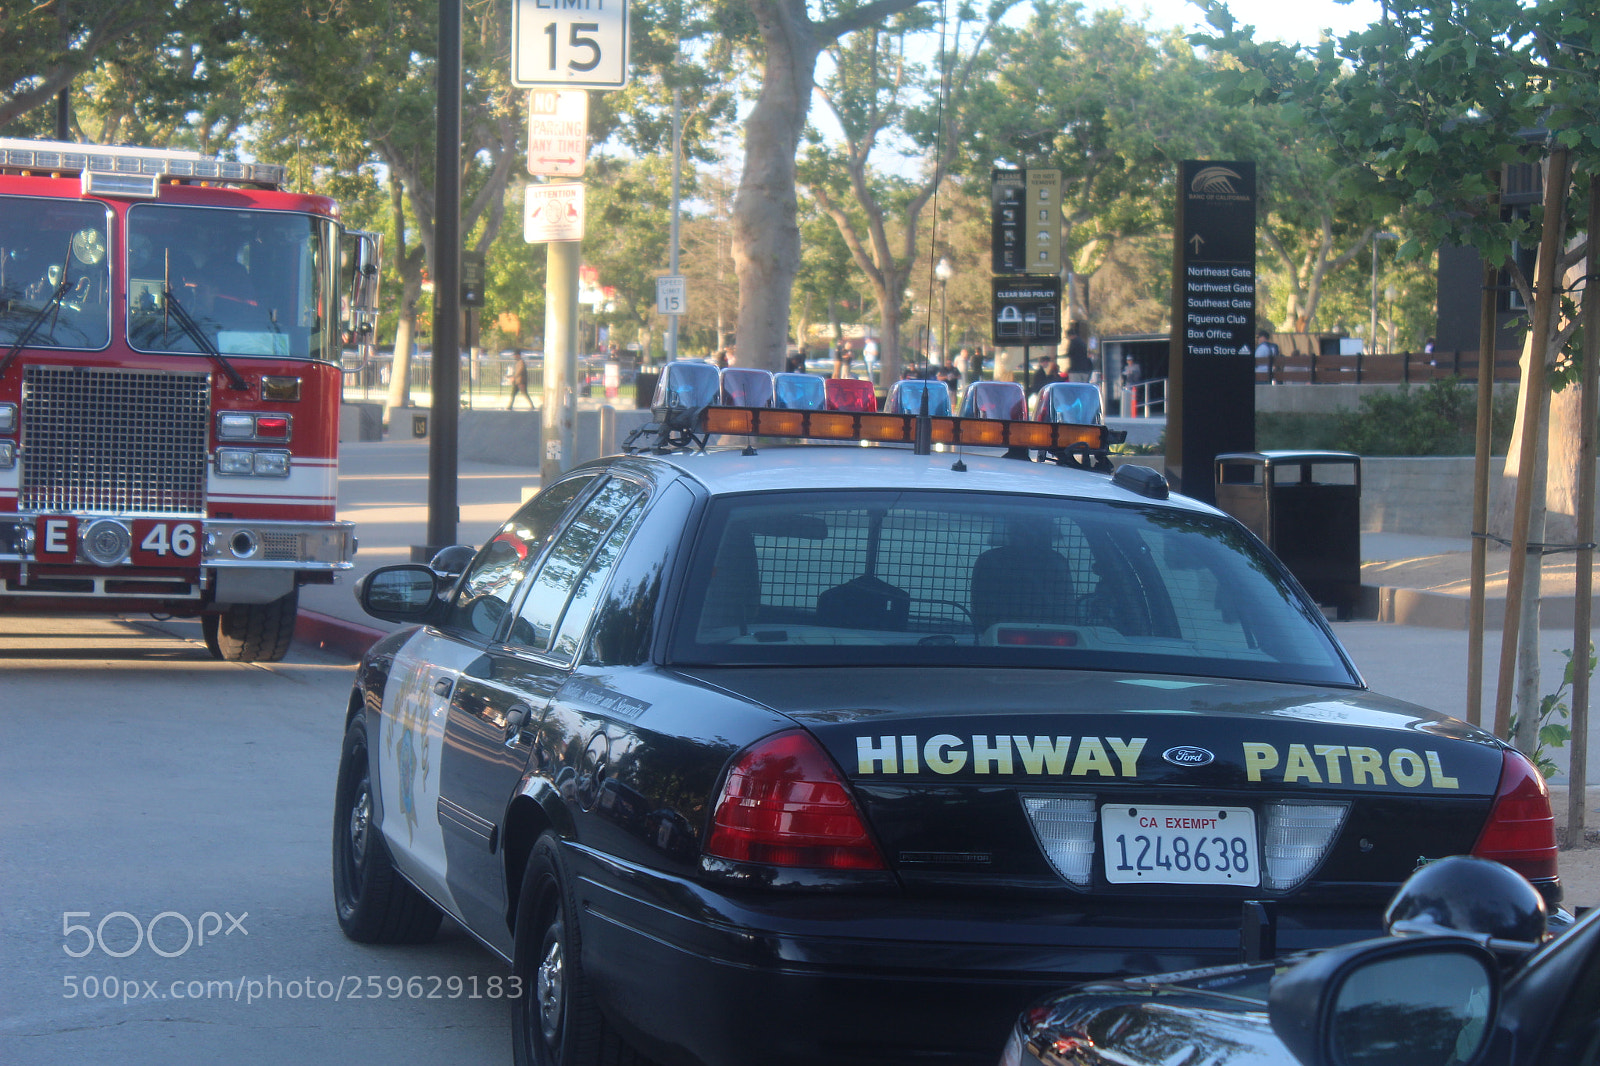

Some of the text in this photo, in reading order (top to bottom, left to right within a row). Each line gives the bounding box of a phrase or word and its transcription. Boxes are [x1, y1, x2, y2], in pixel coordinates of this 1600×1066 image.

[544, 22, 602, 72] 15
[535, 93, 555, 112] NO
[532, 140, 581, 153] ANY TIME
[1188, 267, 1251, 277] Northeast Gate
[1188, 283, 1253, 293] Northwest Gate
[665, 297, 680, 310] 15
[1188, 299, 1251, 308] Southeast Gate
[1188, 314, 1246, 325] Figueroa Club
[1188, 330, 1232, 339] Box Office
[1188, 345, 1236, 355] Team Store
[45, 520, 68, 552] E
[141, 524, 196, 557] 46
[856, 734, 1459, 789] HIGHWAY PATROL
[1175, 750, 1203, 762] Ford
[1139, 817, 1217, 829] CA EXEMPT
[1116, 834, 1249, 872] 1248638
